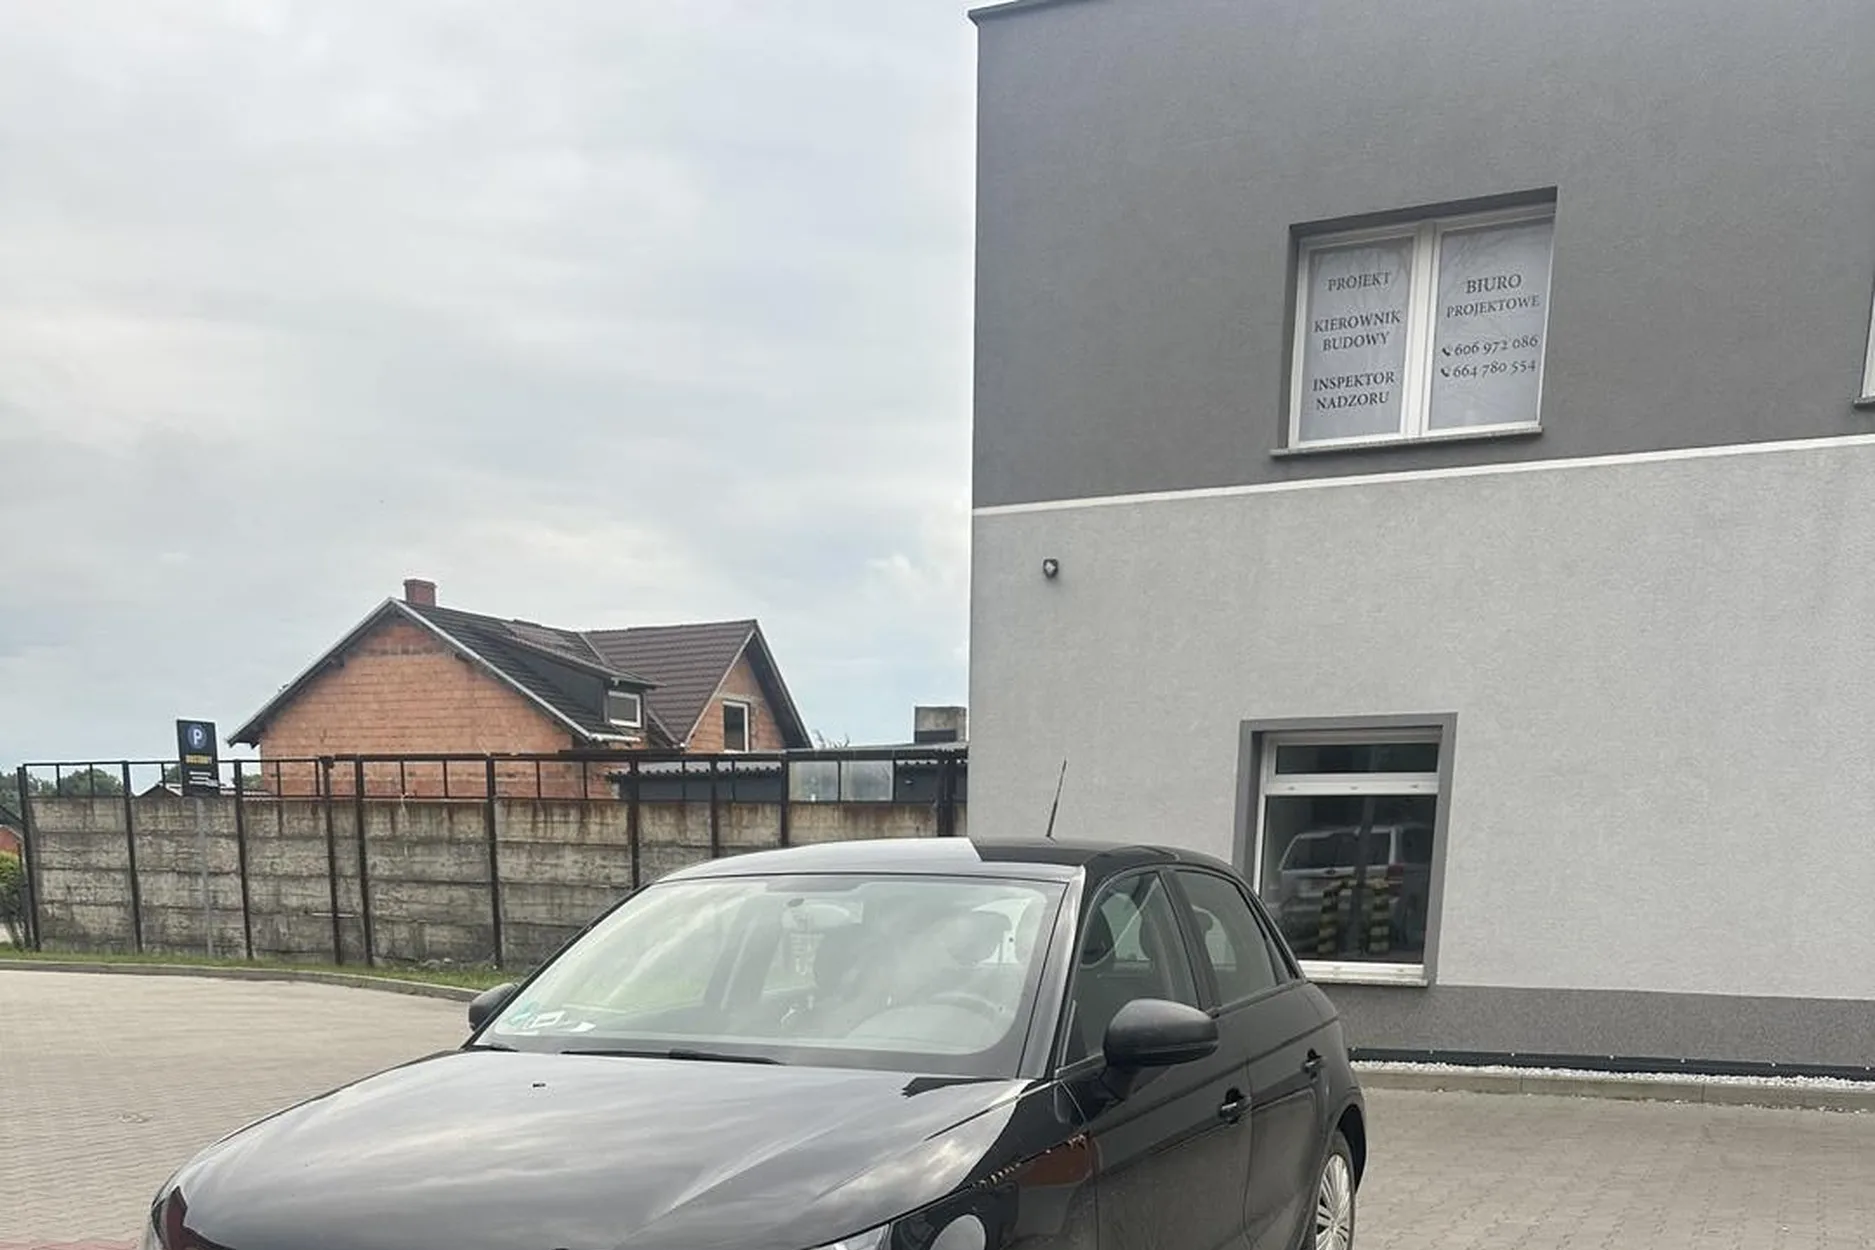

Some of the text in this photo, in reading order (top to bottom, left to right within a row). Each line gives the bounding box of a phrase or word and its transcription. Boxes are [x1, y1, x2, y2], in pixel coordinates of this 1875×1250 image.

[1328, 271, 1391, 291] PROJEKT
[1466, 273, 1522, 294] BIURO
[1446, 295, 1540, 318] PROJEKTOWE
[1314, 310, 1401, 333] KIEROWNIK
[1322, 331, 1390, 351] BUDOWY
[1454, 334, 1538, 356] 606 972 086
[1453, 360, 1536, 379] 664 780 554
[1313, 370, 1395, 391] INSPEKTOR
[1316, 391, 1390, 410] NADZORU
[193, 728, 203, 746] P
